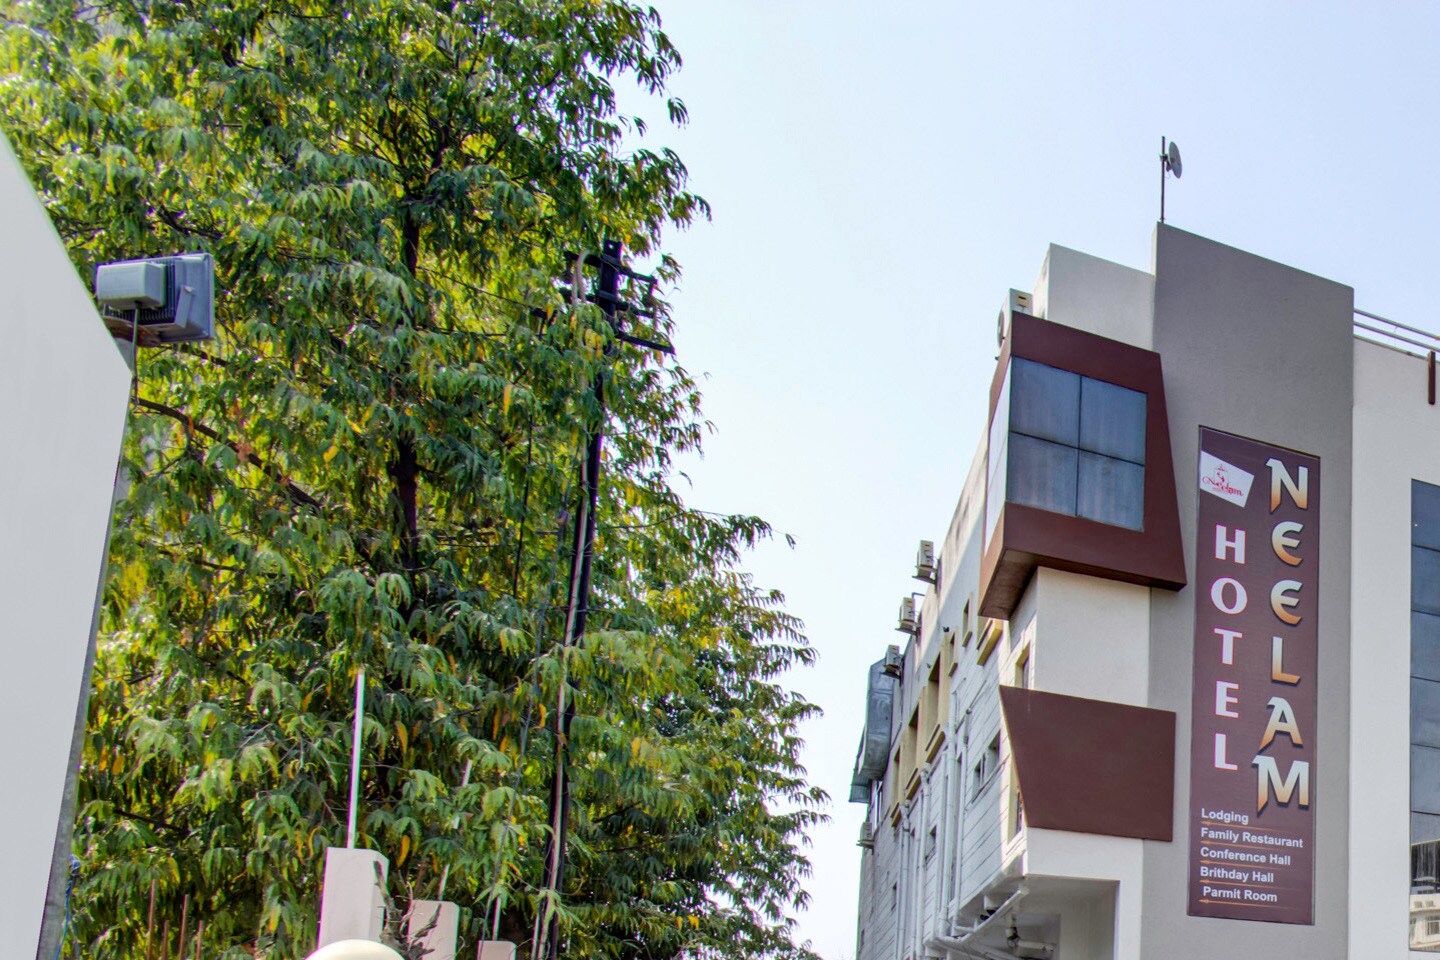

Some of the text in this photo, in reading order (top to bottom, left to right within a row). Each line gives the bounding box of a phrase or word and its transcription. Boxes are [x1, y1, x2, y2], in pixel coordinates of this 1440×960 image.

[1252, 457, 1309, 814] NEELAM
[1210, 524, 1248, 771] HOTEL
[1201, 808, 1249, 825] Lodging
[1201, 827, 1304, 848] Family Restaurant
[1200, 847, 1291, 865] Conference Hall
[1200, 866, 1274, 883] Brithday Hall
[1203, 886, 1278, 902] Parmit Room
